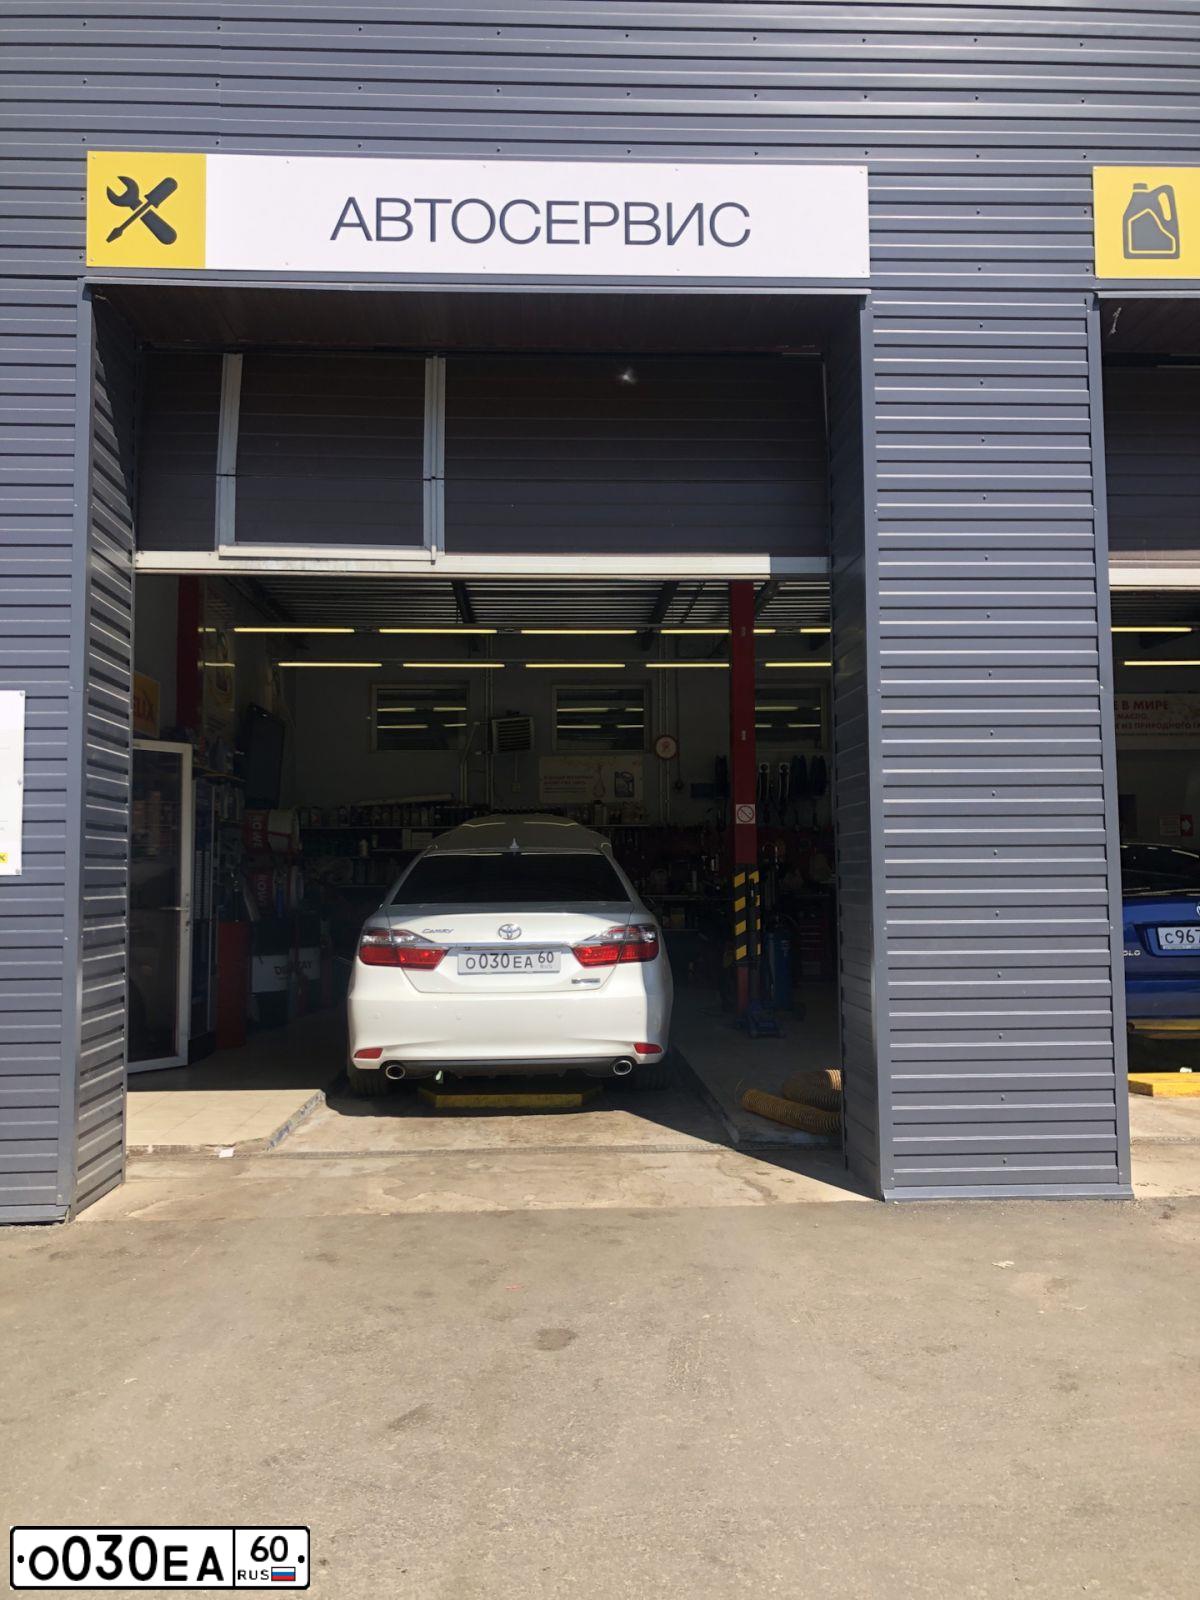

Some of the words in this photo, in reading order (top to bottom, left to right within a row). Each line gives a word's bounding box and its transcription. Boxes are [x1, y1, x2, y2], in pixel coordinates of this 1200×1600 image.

[330, 196, 752, 248] АВТОСЕРВИС
[1133, 699, 1169, 711] МИРЕ
[537, 951, 554, 964] 60
